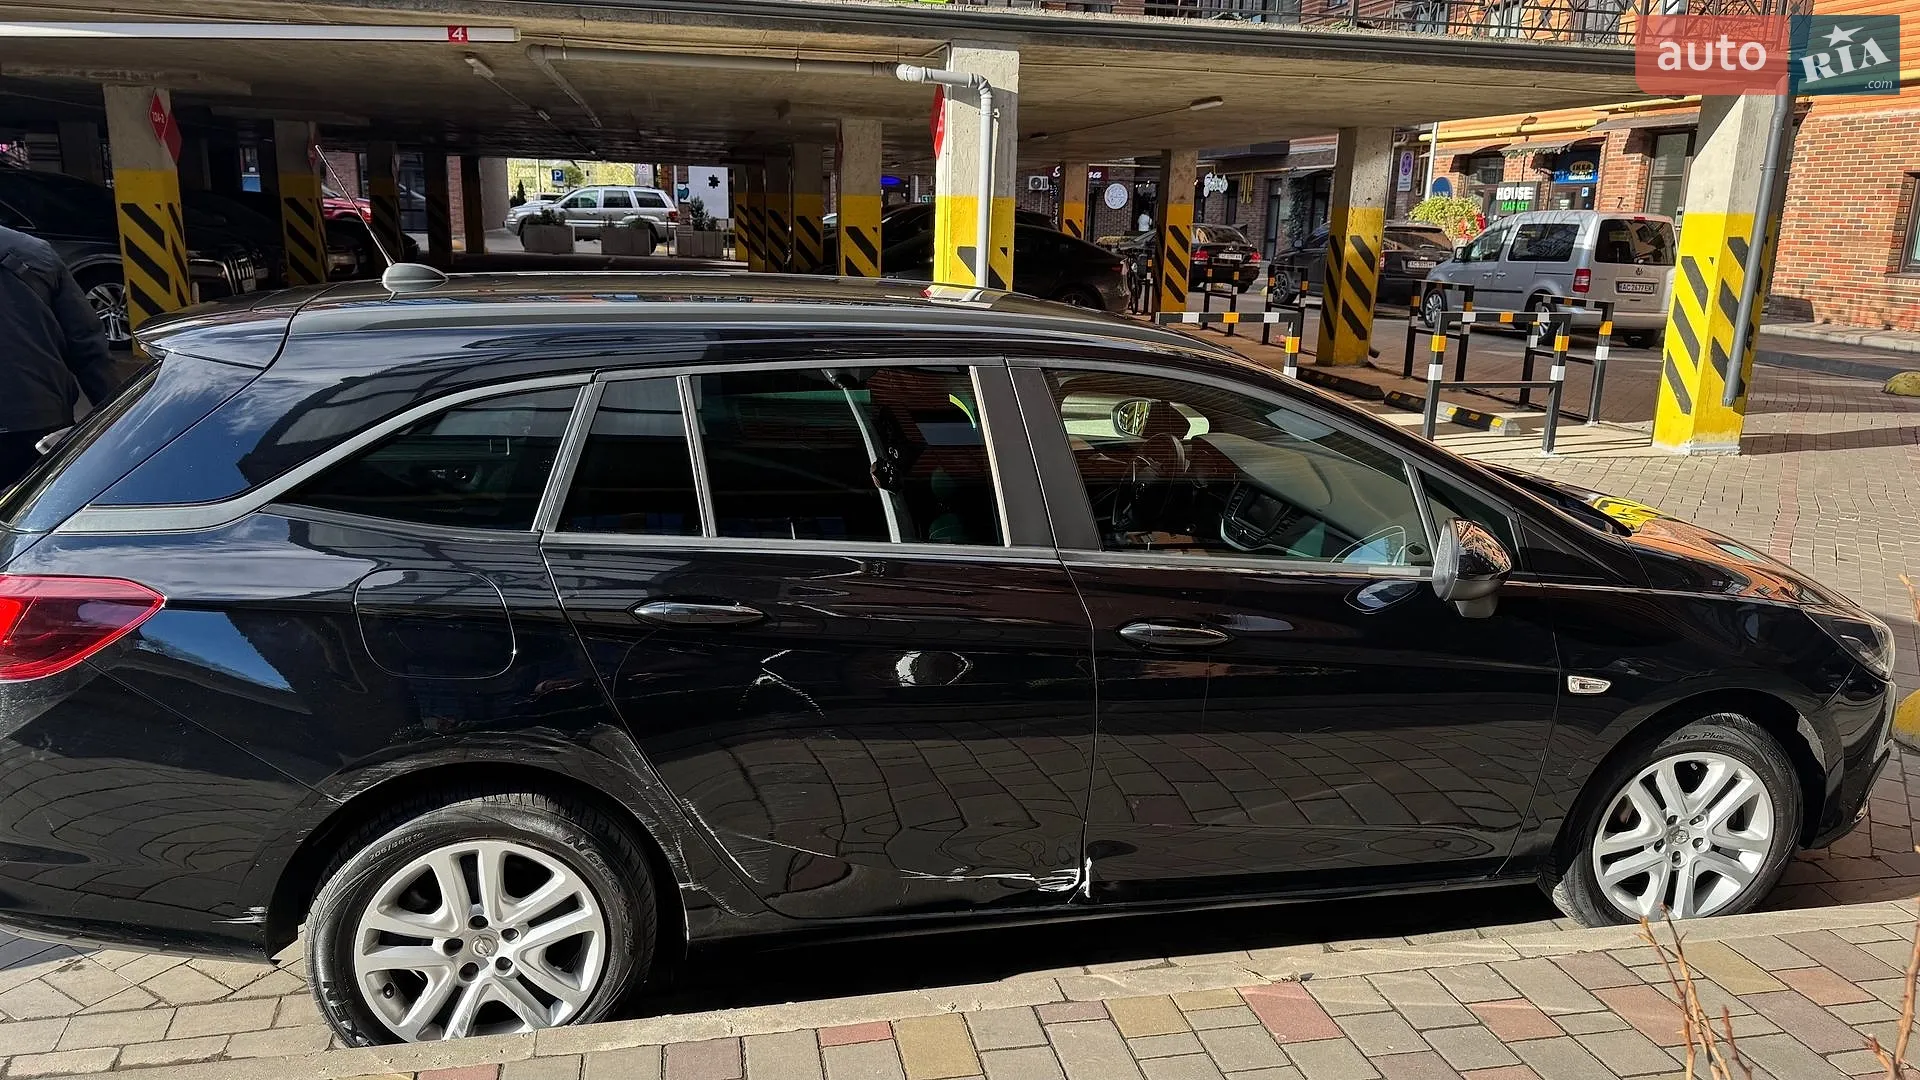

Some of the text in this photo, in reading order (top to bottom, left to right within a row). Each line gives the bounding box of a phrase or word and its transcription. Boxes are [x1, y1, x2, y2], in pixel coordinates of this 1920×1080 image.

[452, 26, 464, 41] 4
[554, 170, 561, 180] P
[1496, 187, 1534, 201] HOUSE
[1501, 201, 1529, 211] MARKET
